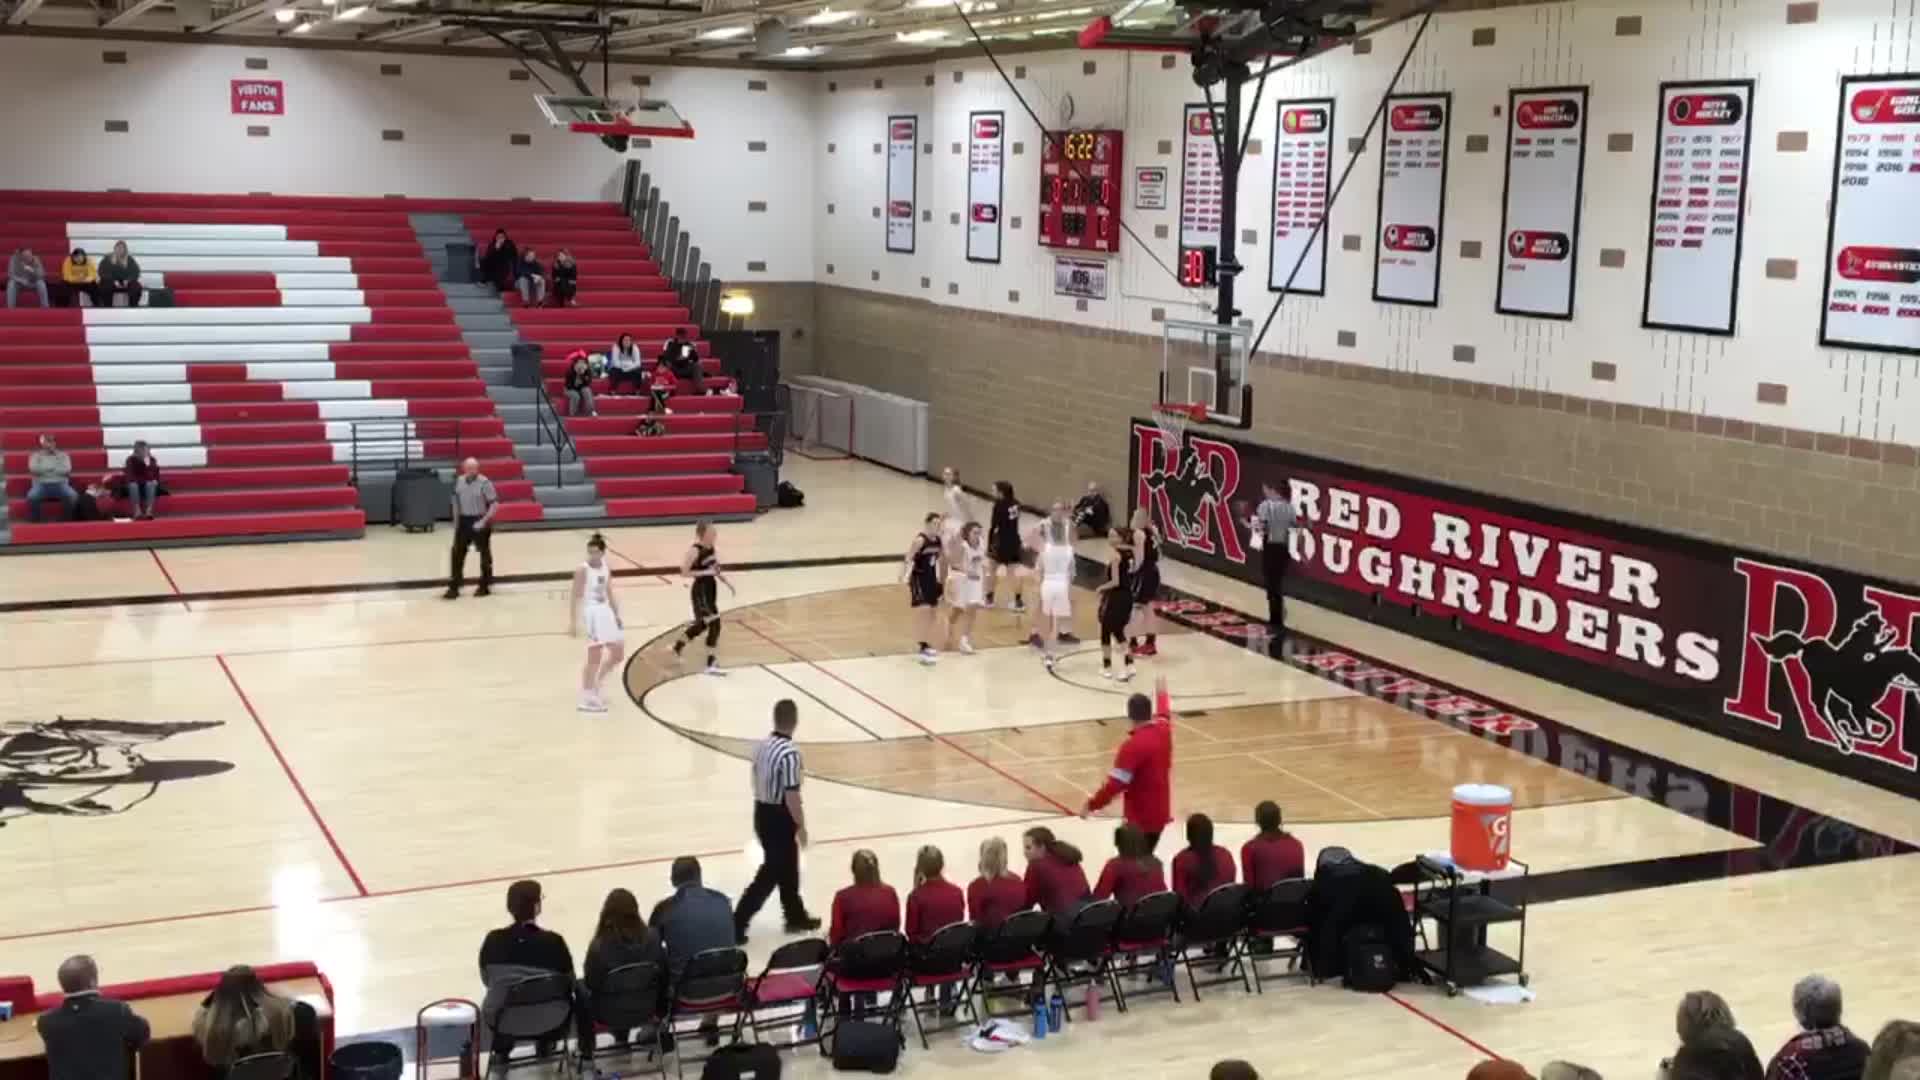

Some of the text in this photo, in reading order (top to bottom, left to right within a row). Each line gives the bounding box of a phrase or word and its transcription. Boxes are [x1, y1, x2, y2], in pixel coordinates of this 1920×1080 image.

[239, 84, 277, 96] VISITOR
[240, 99, 275, 112] FANS
[1183, 250, 1204, 283] 30
[1864, 259, 1920, 272] GYMNASTIC
[1288, 478, 1661, 609] RED RIVER
[1250, 514, 1720, 681] OUGHRIDERS
